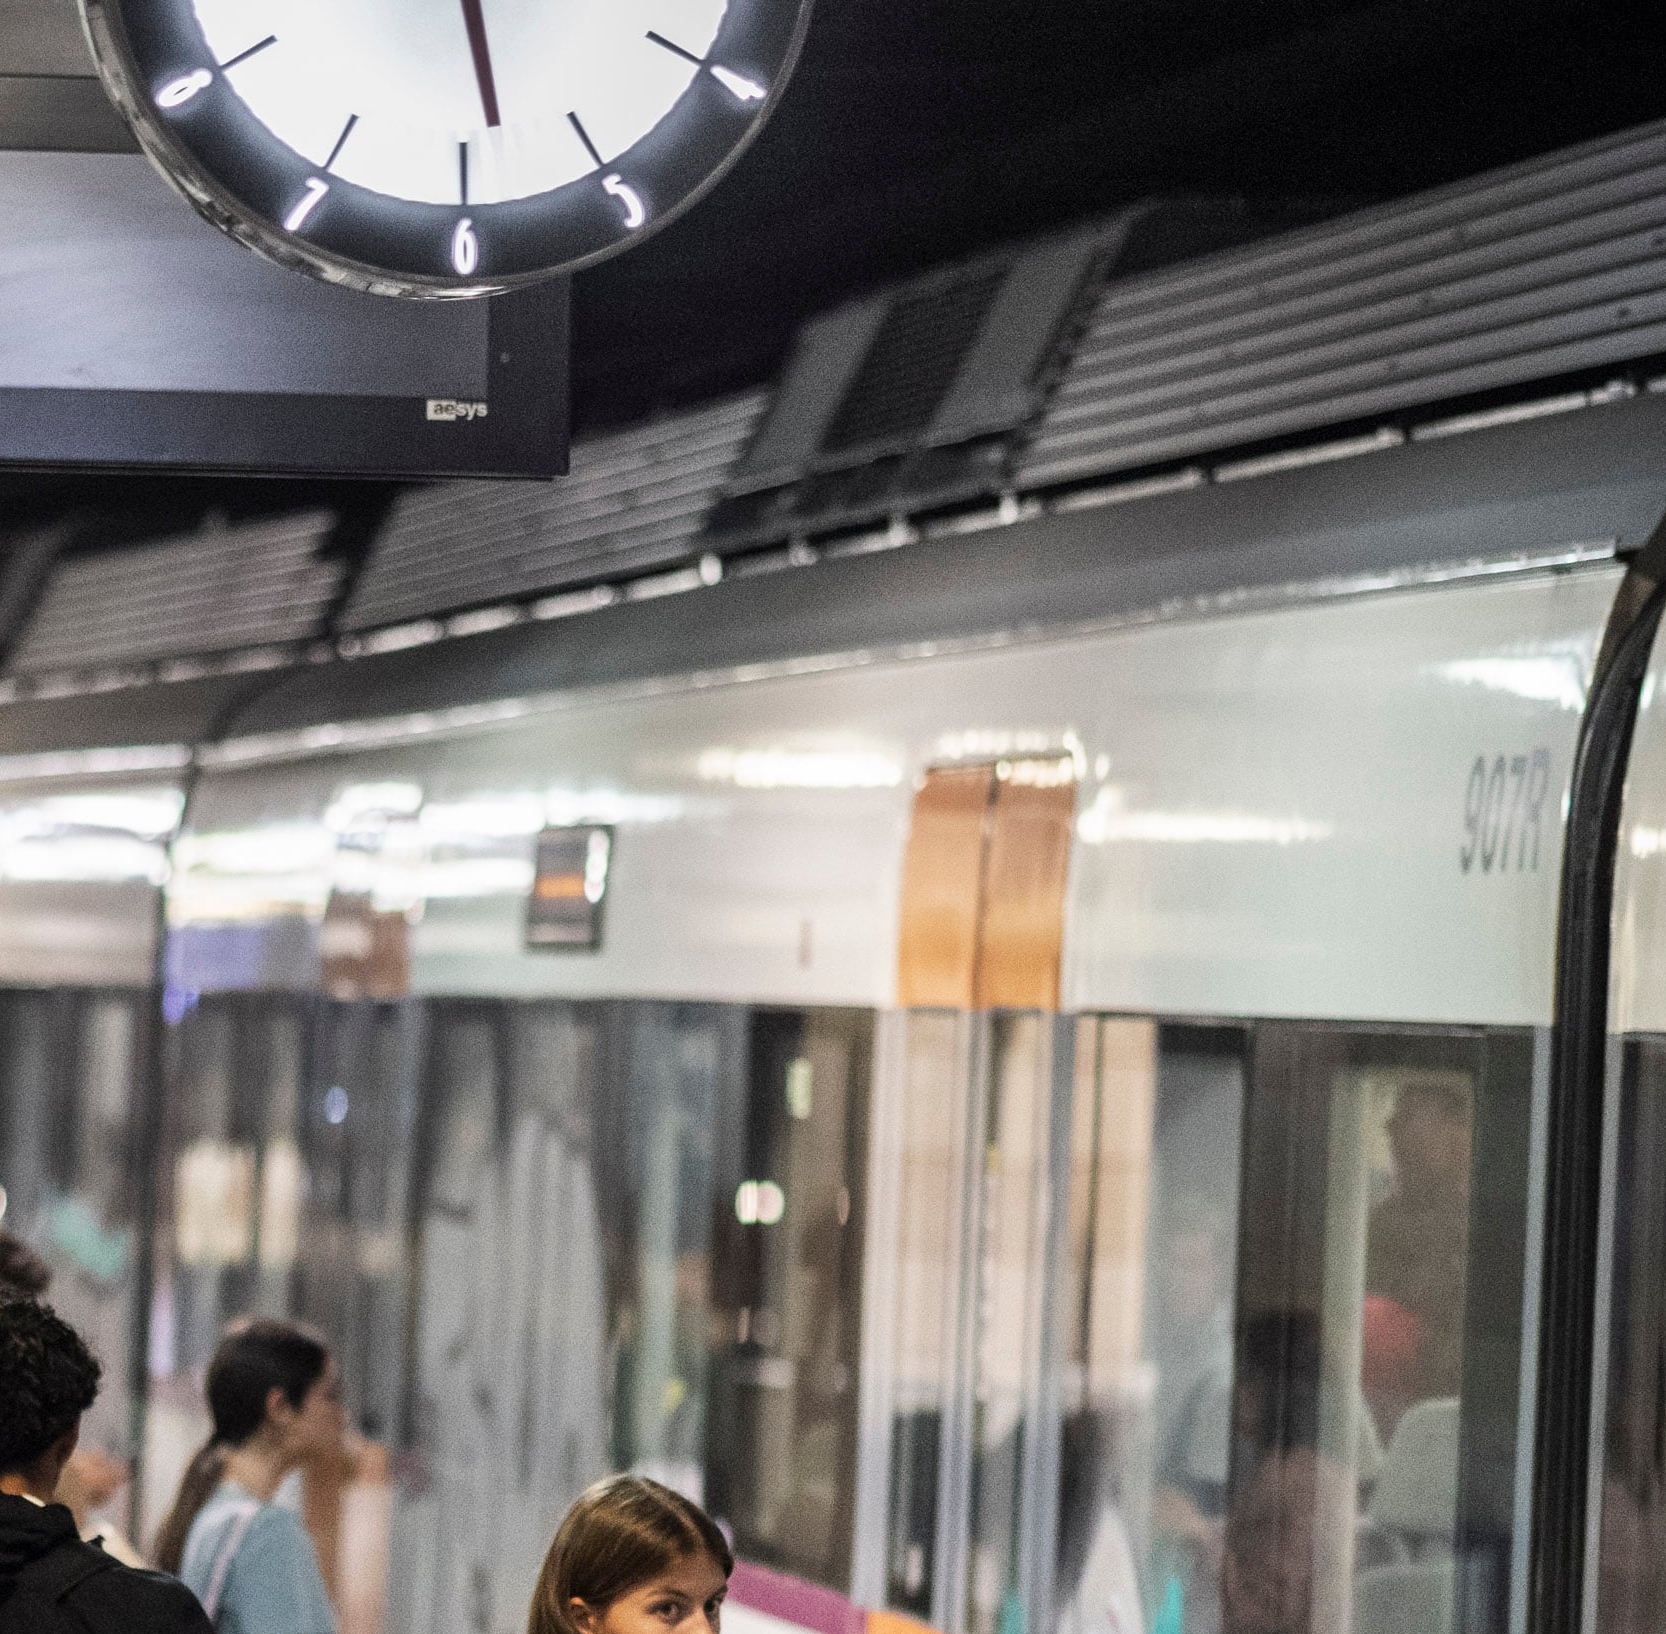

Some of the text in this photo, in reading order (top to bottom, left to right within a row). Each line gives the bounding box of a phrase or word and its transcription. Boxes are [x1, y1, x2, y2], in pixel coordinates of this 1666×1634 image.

[283, 176, 329, 231] 7
[603, 174, 646, 228] 5
[451, 217, 479, 275] 6
